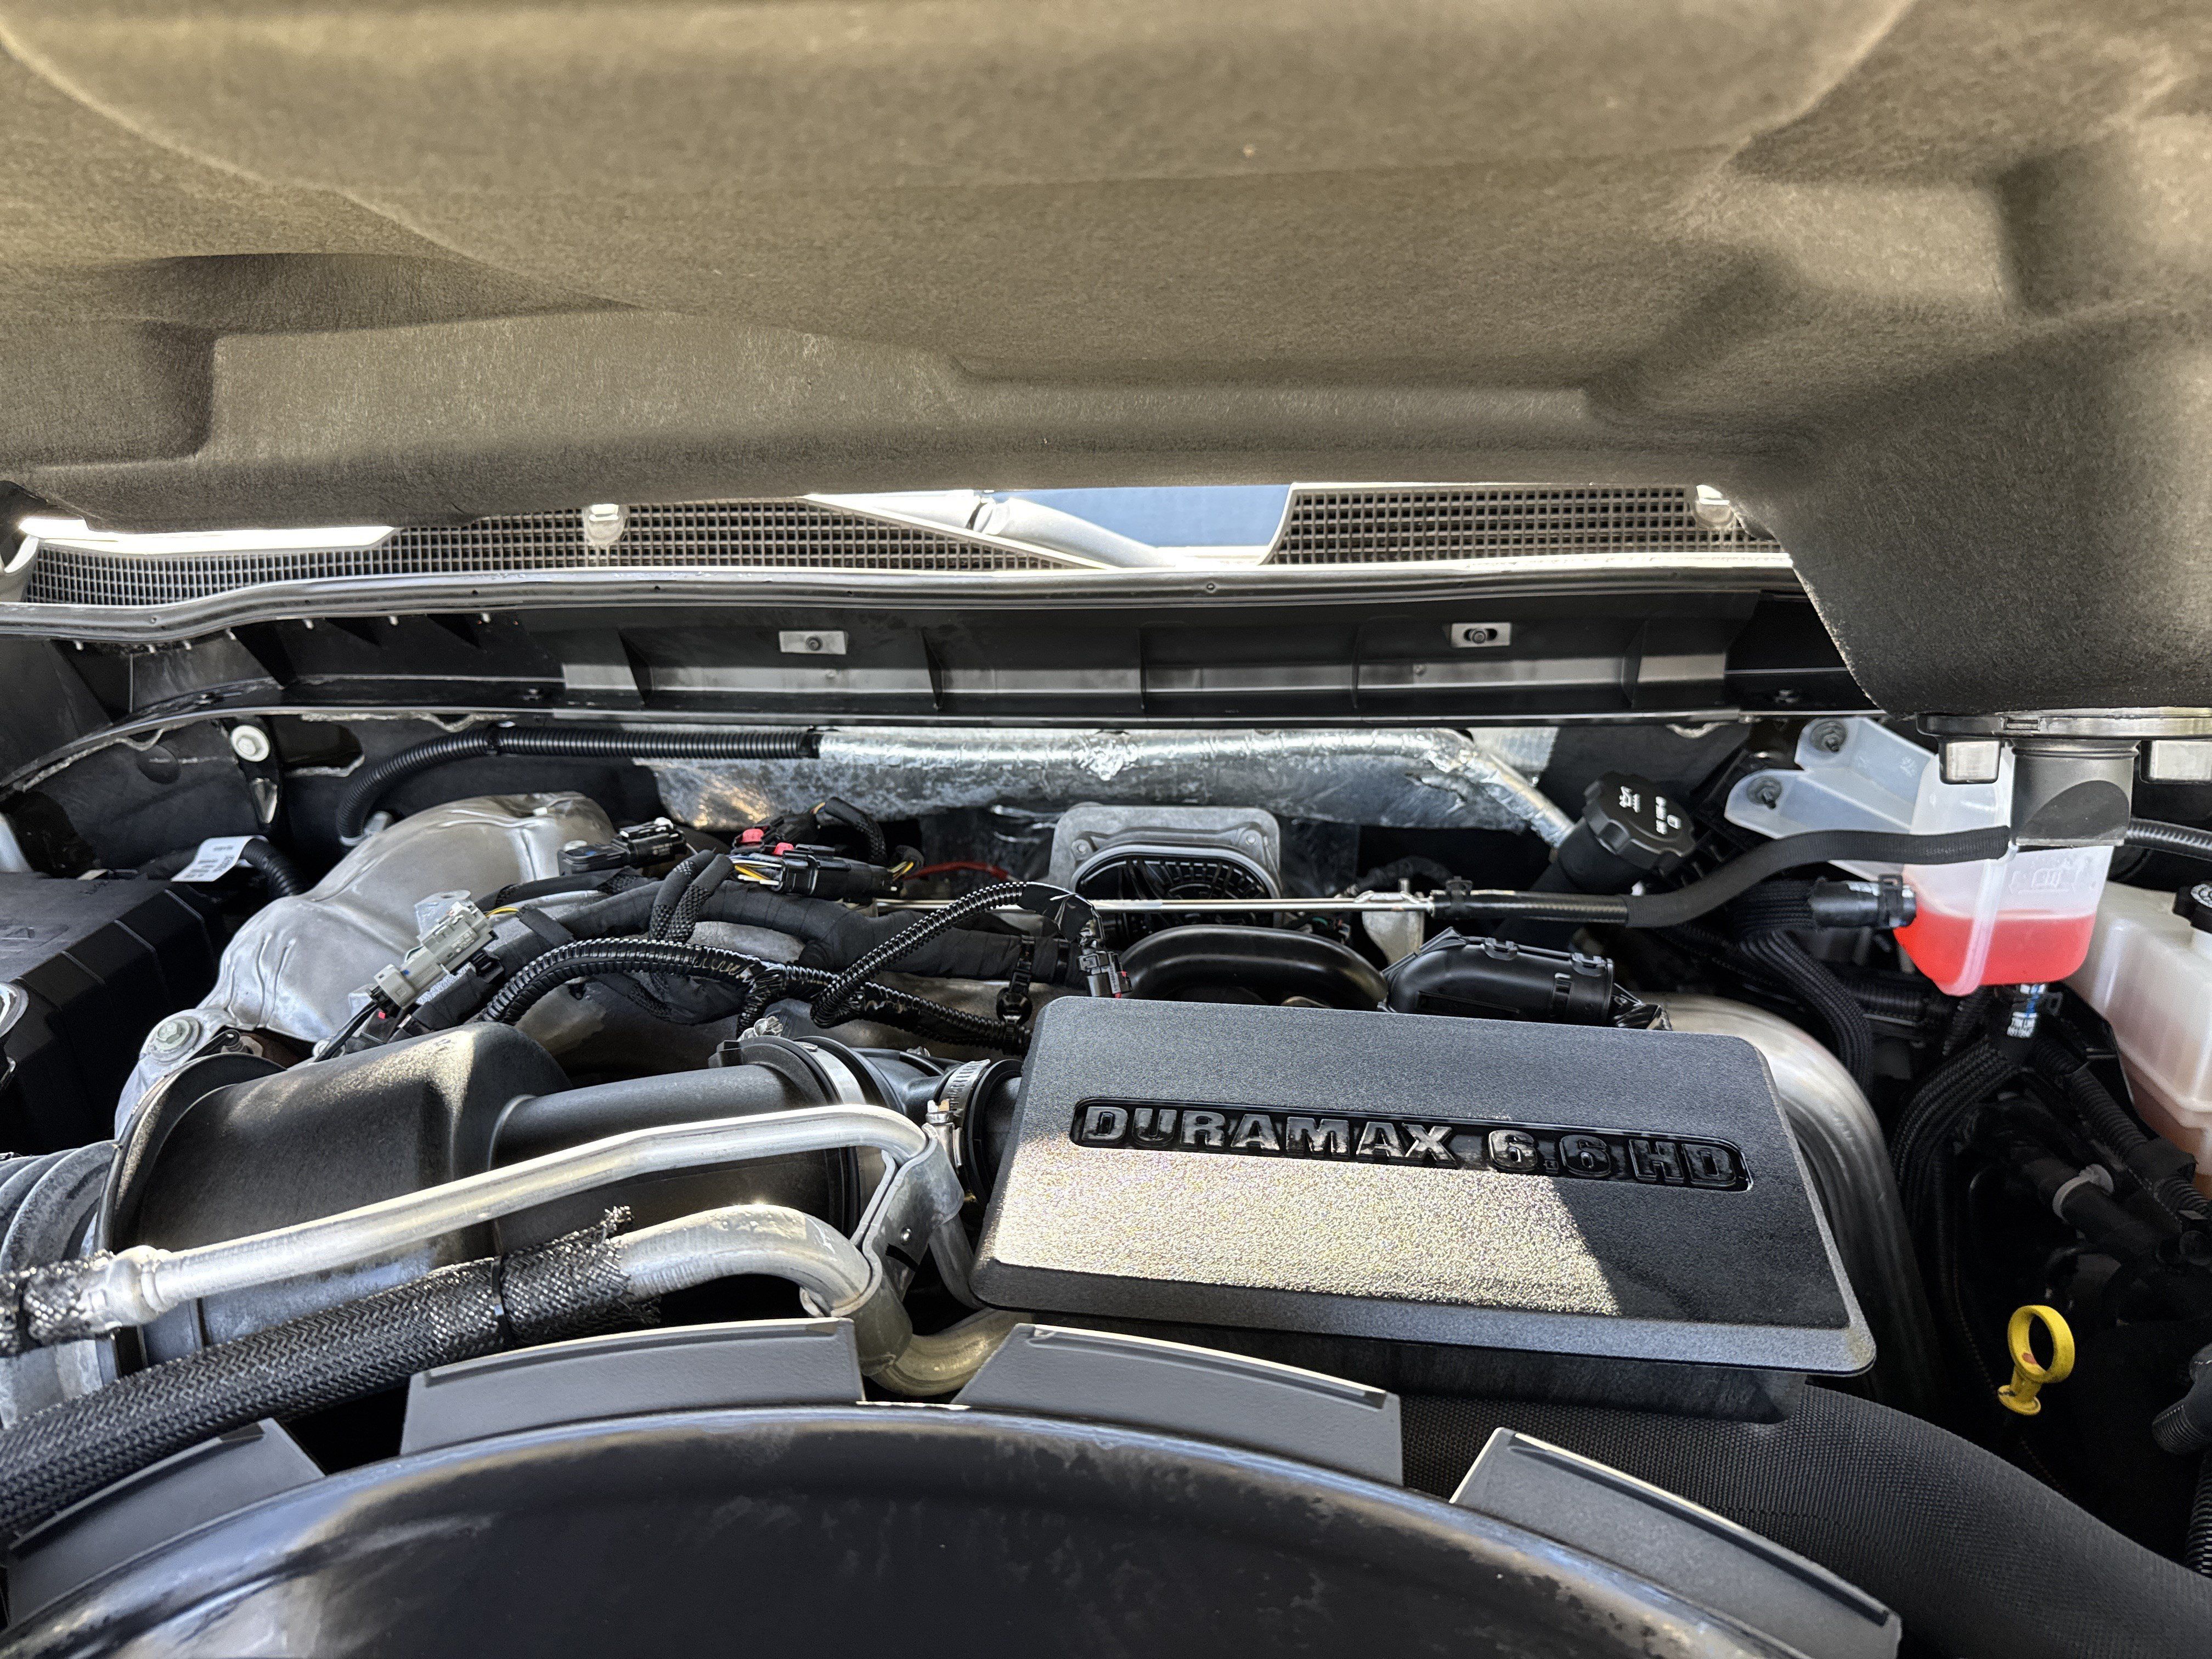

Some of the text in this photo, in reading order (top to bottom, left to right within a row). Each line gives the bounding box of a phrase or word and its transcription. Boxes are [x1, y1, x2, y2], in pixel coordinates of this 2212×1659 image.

[1079, 1106, 1737, 1188] DURAMAX 6.6 HD
